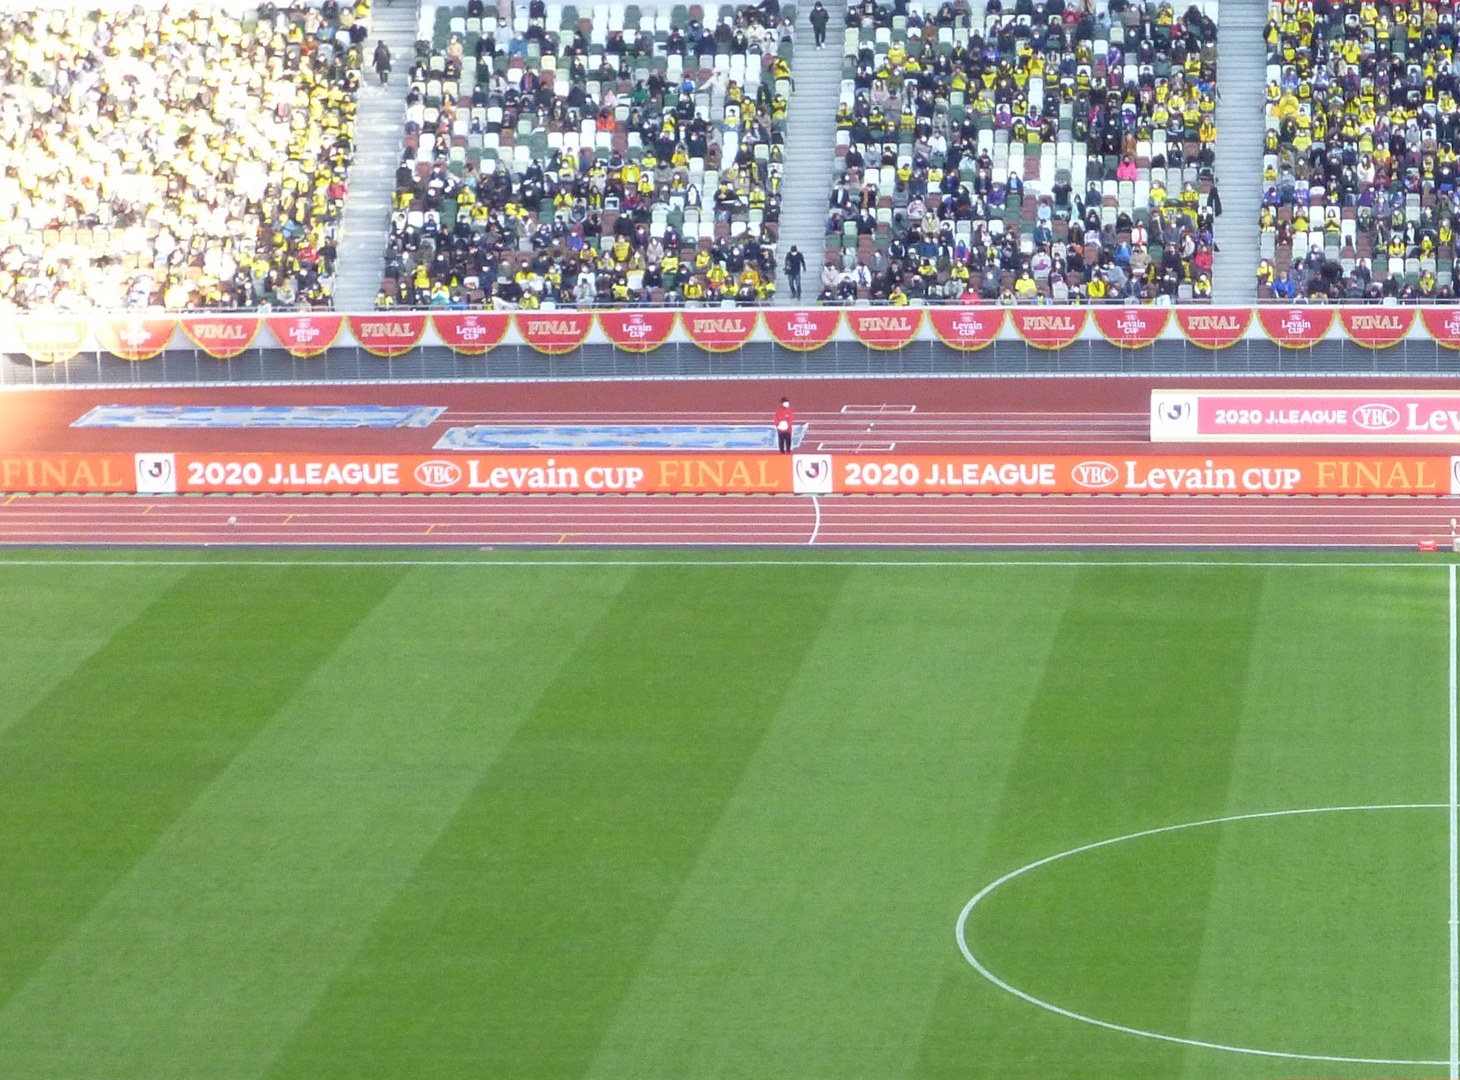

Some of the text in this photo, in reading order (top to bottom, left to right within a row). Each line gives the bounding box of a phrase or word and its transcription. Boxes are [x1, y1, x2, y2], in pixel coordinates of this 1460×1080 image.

[361, 323, 414, 337] FINAL
[528, 321, 580, 335] FINAL
[622, 323, 652, 333] Levain
[693, 318, 745, 332] FINAL
[788, 322, 817, 332] Levain
[859, 317, 911, 331] FINAL
[953, 320, 982, 330] Levain
[1023, 317, 1075, 331] FINAL
[1117, 320, 1146, 330] Levain
[1188, 316, 1240, 330] FINAL
[1282, 319, 1310, 330] Levain
[1351, 316, 1403, 330] FINAL
[193, 324, 247, 340] FINAL
[289, 327, 319, 338] Levain
[456, 325, 486, 336] Levain
[1215, 410, 1262, 424] 2020
[1265, 410, 1348, 424] J.LEAGUE
[1361, 408, 1393, 426] YBC
[1, 459, 122, 487] FINAL
[187, 462, 262, 485] 2020
[268, 462, 399, 485] J.LEAGUE
[421, 464, 454, 483] YBC
[467, 458, 579, 489] Levain
[584, 466, 644, 489] CUP
[657, 459, 778, 488] FINAL
[844, 463, 919, 486] 2020
[925, 463, 1055, 486] J.LEAGUE
[1079, 466, 1111, 484] YBC
[1124, 460, 1236, 489] Levain
[1242, 467, 1301, 490] CUP
[1315, 460, 1436, 489] FINAL
